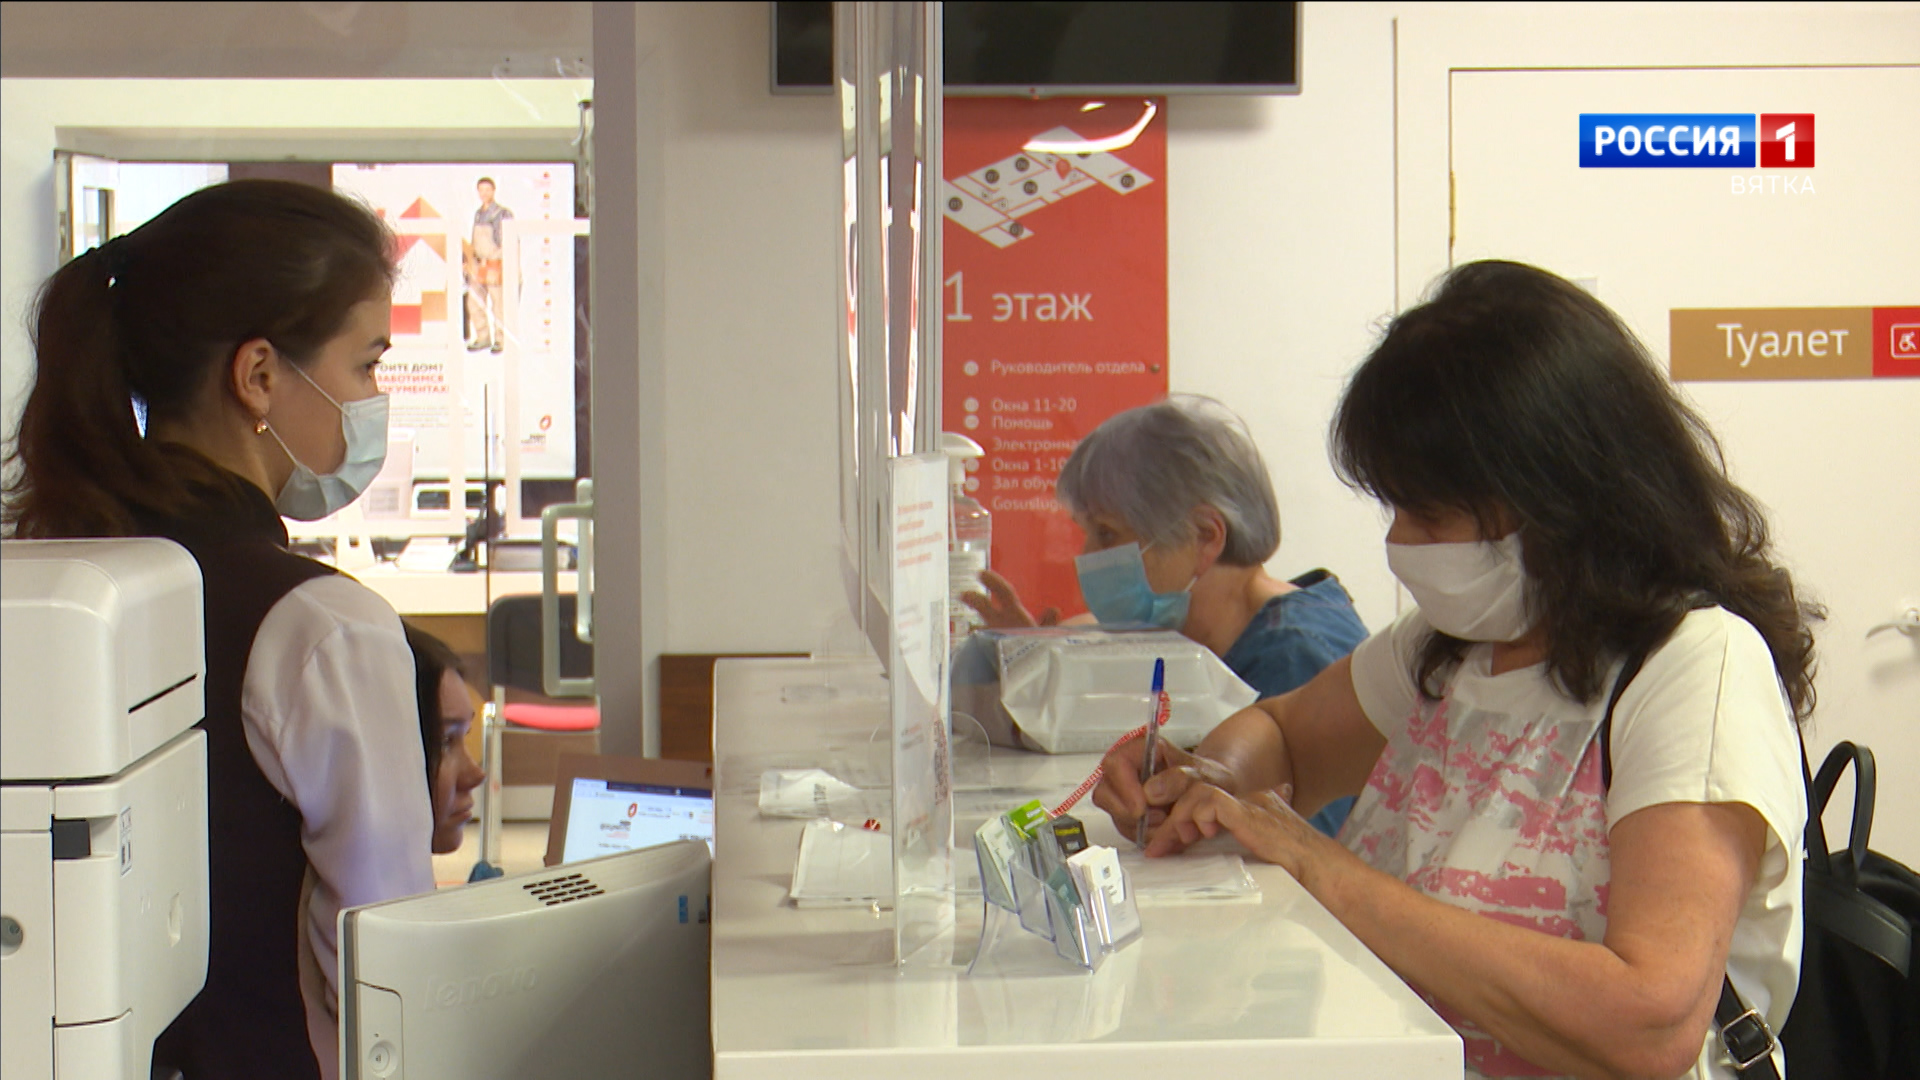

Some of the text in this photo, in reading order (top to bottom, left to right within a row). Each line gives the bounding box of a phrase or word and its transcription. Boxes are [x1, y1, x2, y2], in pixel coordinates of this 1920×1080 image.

[944, 270, 1094, 322] 1 этаж
[1715, 322, 1850, 368] Туалет
[990, 359, 1093, 376] Руководитель
[1094, 360, 1146, 375] отдела
[377, 373, 445, 383] ЗАБОТИМСЯ
[378, 384, 450, 394] ОКУМЕНТАХ!
[991, 398, 1029, 412] Окна
[1033, 397, 1077, 412] 11-20
[991, 415, 1053, 430] Помощь
[991, 437, 1078, 453] Электронна
[991, 457, 1029, 471] Окна
[991, 476, 1019, 490] Зал
[1022, 475, 1058, 492] обуч
